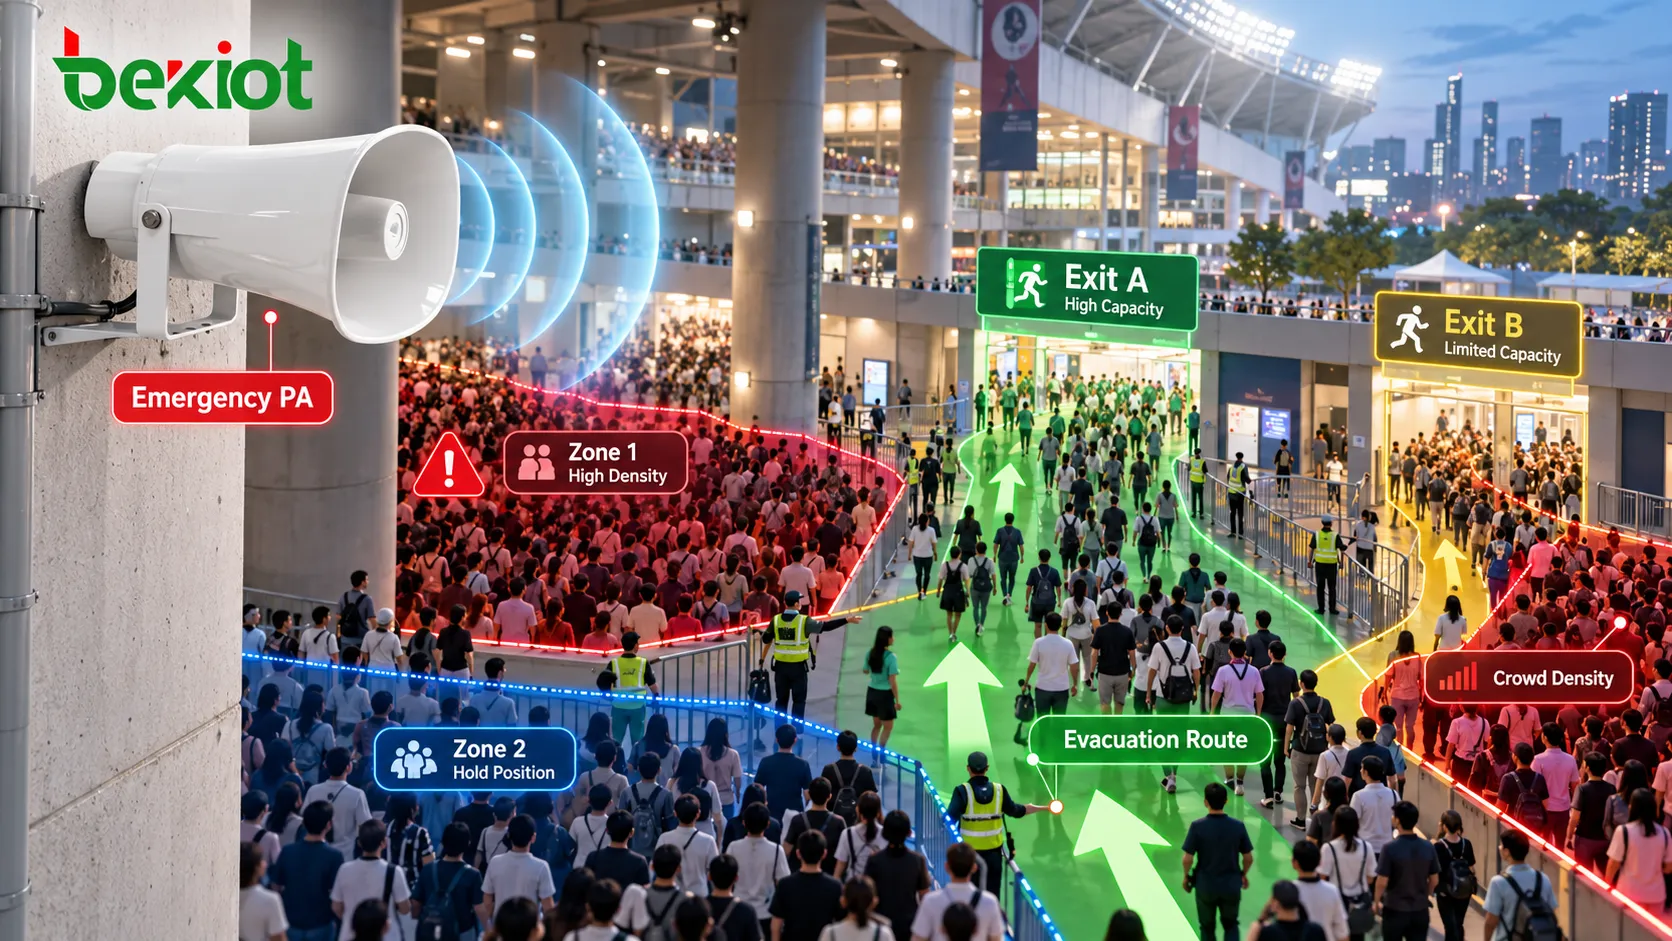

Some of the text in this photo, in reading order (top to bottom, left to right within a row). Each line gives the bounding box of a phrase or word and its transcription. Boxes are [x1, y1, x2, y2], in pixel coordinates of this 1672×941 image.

[1065, 263, 1149, 293] Exit A
[1065, 297, 1164, 319] High Capacity
[1445, 308, 1523, 338] Exit B
[1444, 341, 1562, 366] Limited Capacity
